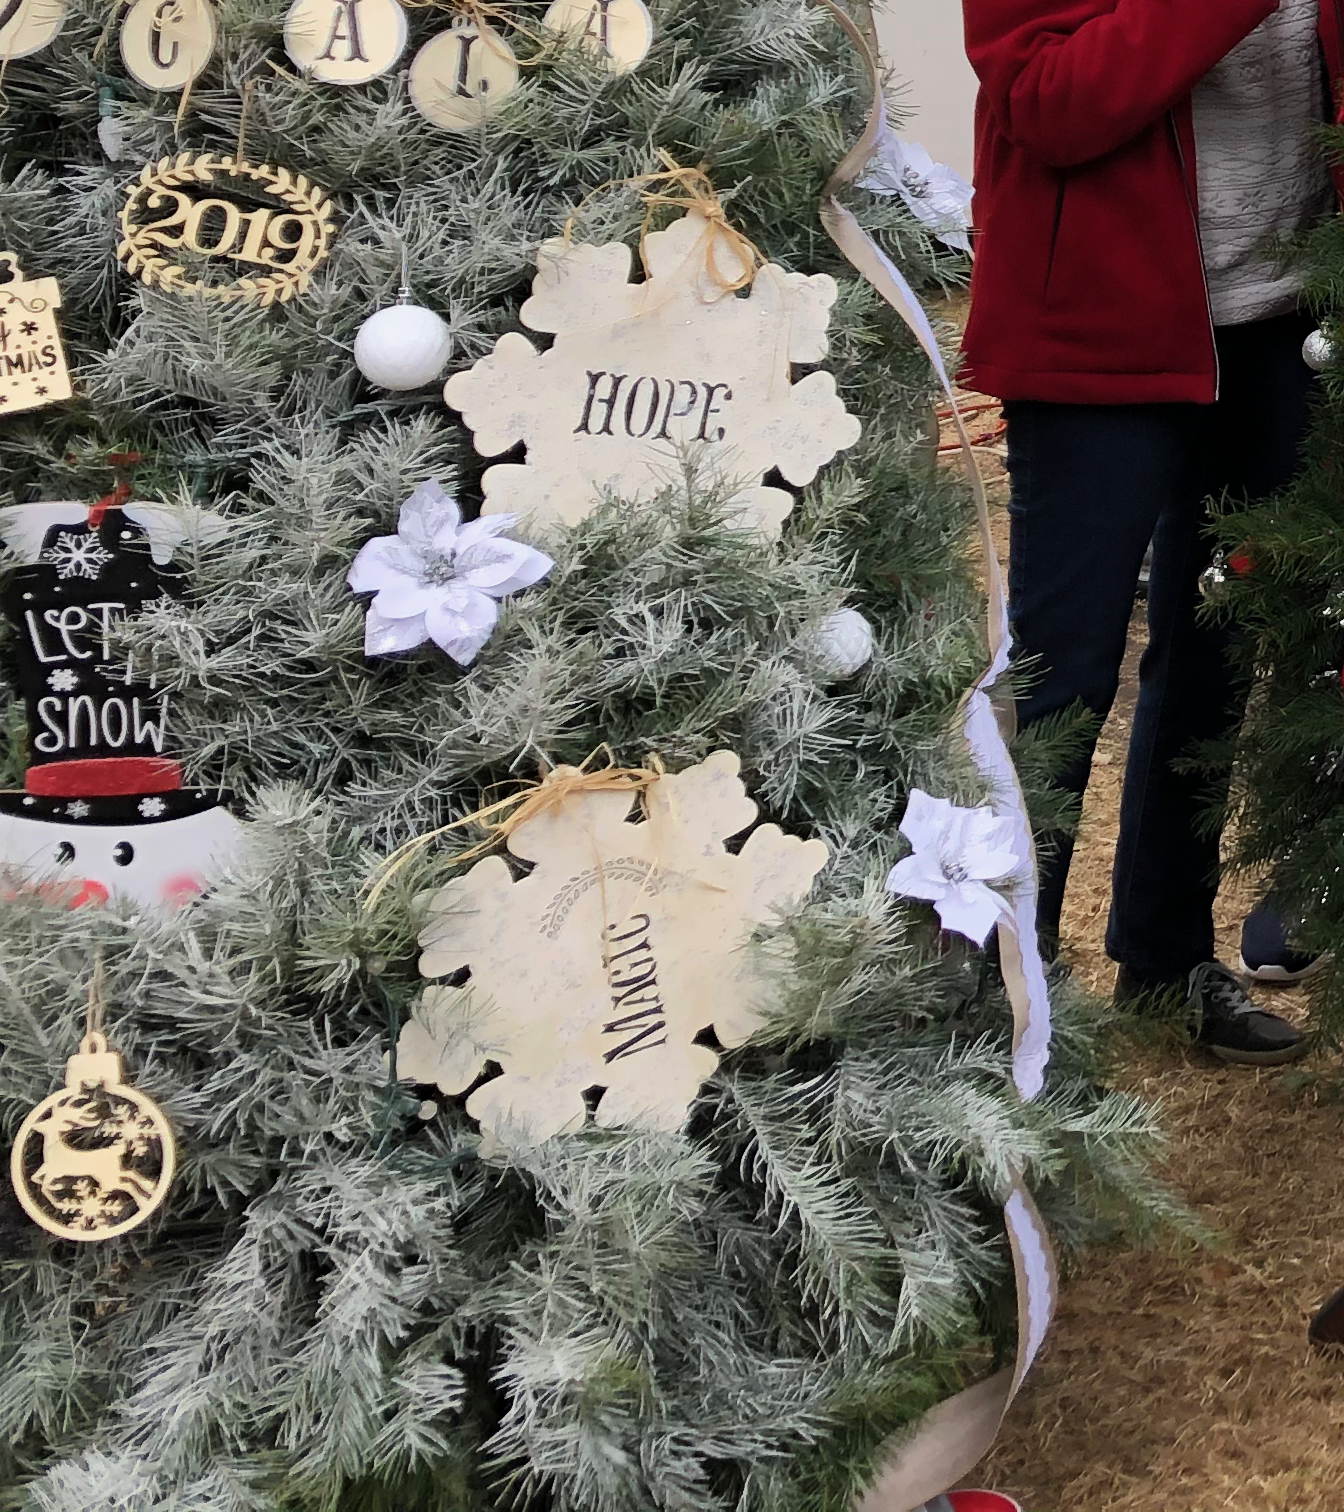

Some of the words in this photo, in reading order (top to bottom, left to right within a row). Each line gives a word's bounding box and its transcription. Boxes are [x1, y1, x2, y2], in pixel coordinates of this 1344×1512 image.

[137, 189, 311, 274] 2019
[572, 370, 733, 443] HOPE
[600, 913, 670, 1065] MAGIC
